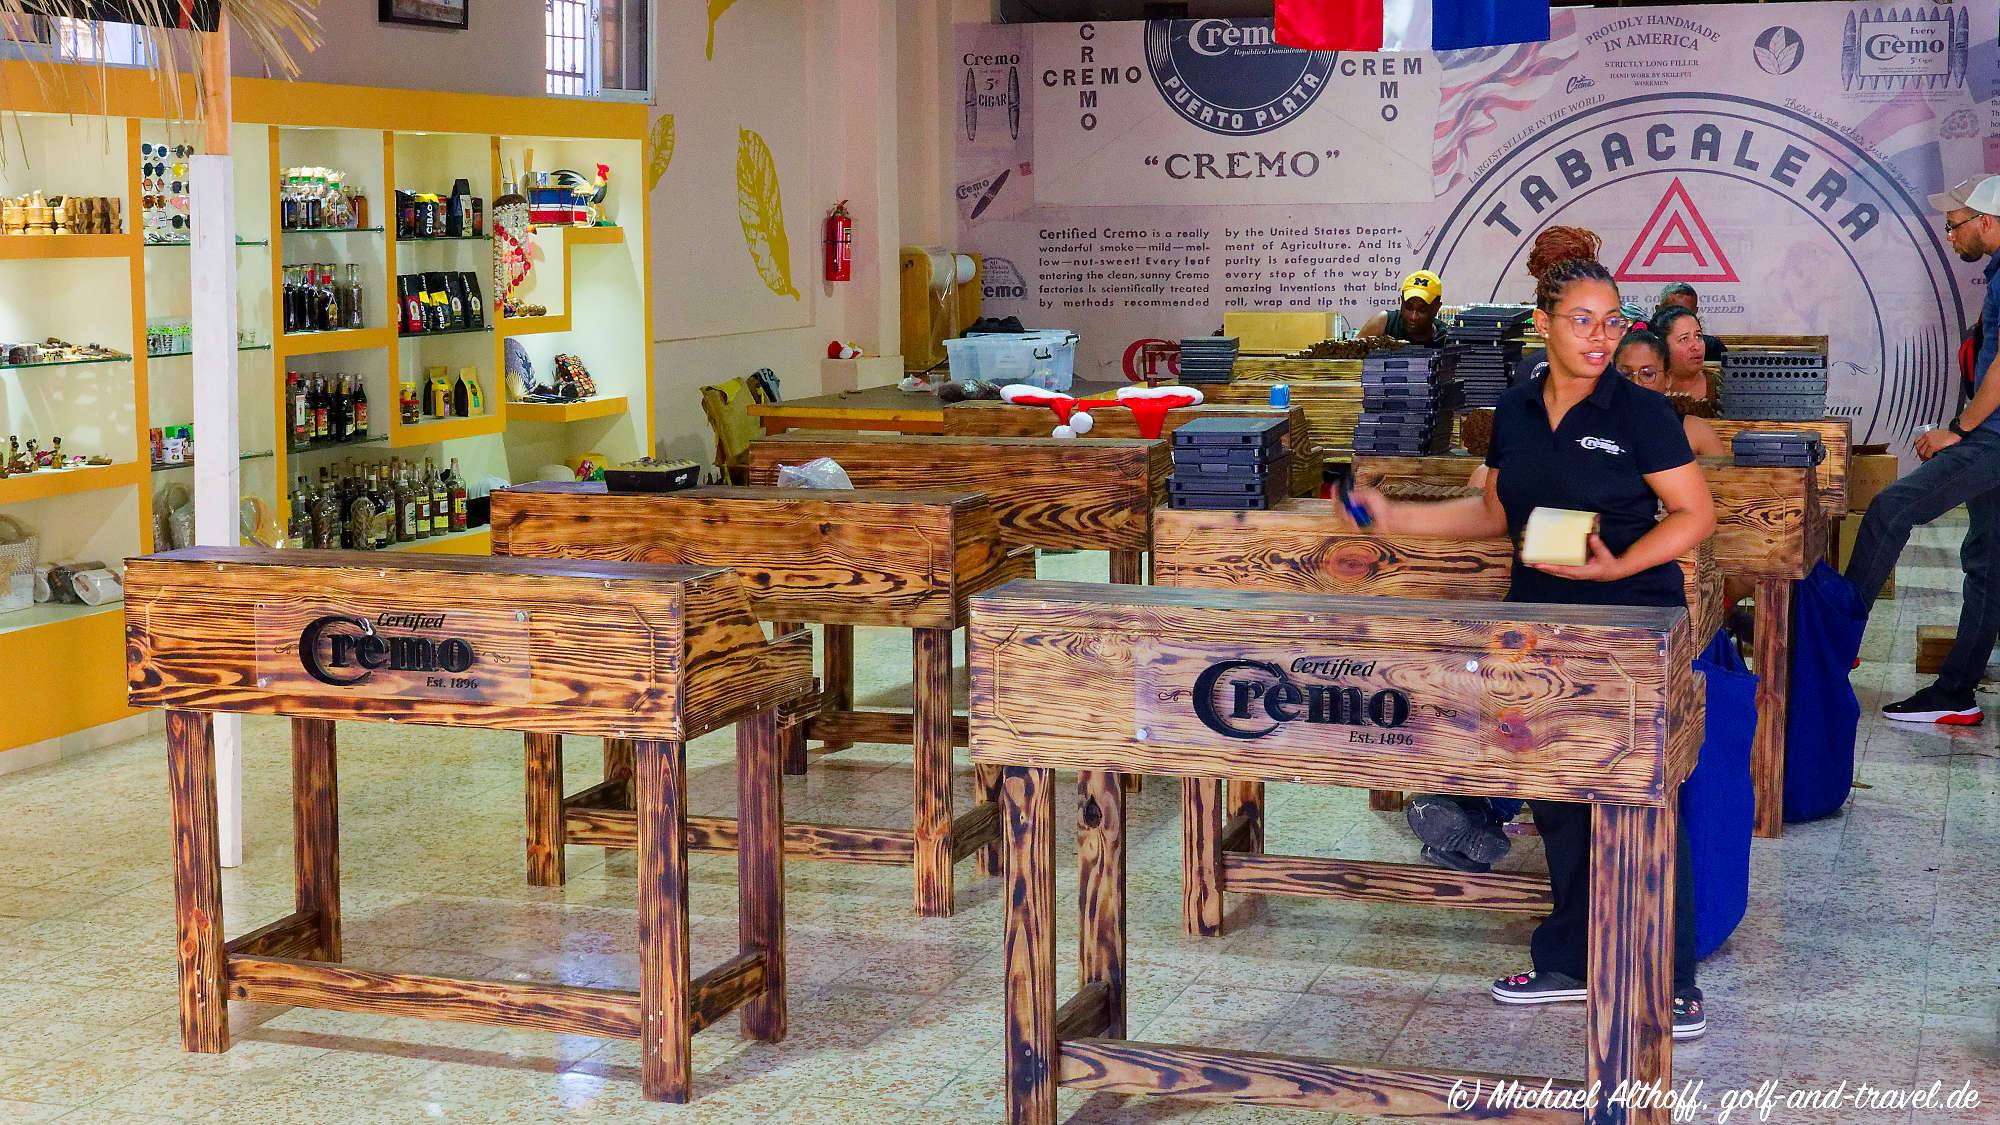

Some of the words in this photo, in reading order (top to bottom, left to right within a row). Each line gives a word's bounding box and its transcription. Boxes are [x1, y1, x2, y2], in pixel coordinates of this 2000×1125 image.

[1584, 15, 1643, 46] PROUDLY
[1646, 15, 1721, 43] HANDMADE
[1604, 37, 1622, 53] IN
[1626, 32, 1699, 51] AMERICA
[963, 53, 1020, 66] Cremo
[1604, 60, 1644, 68] STRICTLY
[1670, 59, 1699, 67] FILLER
[1042, 66, 1142, 87] CREMO
[978, 93, 1007, 107] CIGAR
[1164, 75, 1243, 129] PUERTO
[1255, 73, 1320, 127] PLATA
[1467, 147, 1503, 184] LARGEST
[1503, 125, 1535, 150] SELLER
[1537, 119, 1546, 130] IN
[1546, 107, 1567, 122] THE
[1568, 94, 1605, 112] WORLD
[1483, 122, 1881, 243] TABACALERA
[1039, 227, 1097, 240] Certified
[1103, 228, 1148, 239] Cremo
[1152, 229, 1161, 238] is
[1177, 228, 1210, 240] really
[1225, 228, 1240, 239] by
[1245, 228, 1264, 237] the
[1270, 227, 1309, 236] United
[1314, 227, 1350, 236] States
[1356, 226, 1402, 237] Depart-
[1642, 210, 1709, 267] A
[1039, 243, 1093, 253] wonderful
[1225, 242, 1254, 251] ment
[1262, 241, 1275, 250] of
[1280, 240, 1351, 252] Agriculture.
[1358, 240, 1382, 249] And
[1145, 256, 1180, 267] Every
[1185, 256, 1211, 266] leaf
[1225, 255, 1261, 266] purity
[1268, 255, 1277, 264] is
[1284, 254, 1360, 266] safeguarded
[1368, 253, 1401, 265] along
[1039, 271, 1083, 282] entering
[1087, 270, 1104, 280] the
[1108, 270, 1138, 281] clean,
[1140, 273, 1172, 282] sunny
[1176, 270, 1210, 280] Cremo
[1225, 271, 1261, 280] every
[1269, 270, 1296, 280] step
[1303, 268, 1316, 278] of
[1324, 268, 1344, 278] the
[1352, 269, 1379, 279] way
[1385, 268, 1400, 279] by
[1225, 283, 1272, 294] amazing
[1279, 283, 1336, 292] inventions
[1343, 282, 1366, 292] that
[1374, 282, 1401, 293] bind,
[1413, 277, 1429, 287] M
[1039, 284, 1084, 294] factories
[1088, 284, 1096, 294] is
[1101, 283, 1165, 295] scientifically
[1170, 283, 1210, 293] treated
[1039, 298, 1053, 309] by
[1063, 298, 1114, 307] methods
[1124, 297, 1210, 307] recommended
[1225, 297, 1248, 308] roll,
[1253, 298, 1283, 308] wrap
[1289, 297, 1311, 306] and
[1317, 297, 1332, 308] tip
[1339, 297, 1357, 306] the
[377, 612, 446, 632] Certified
[1290, 657, 1377, 678] Certified
[426, 676, 447, 689] Est.
[450, 678, 478, 690] 1896
[1348, 730, 1376, 744] Est.
[1379, 732, 1414, 747] 1896
